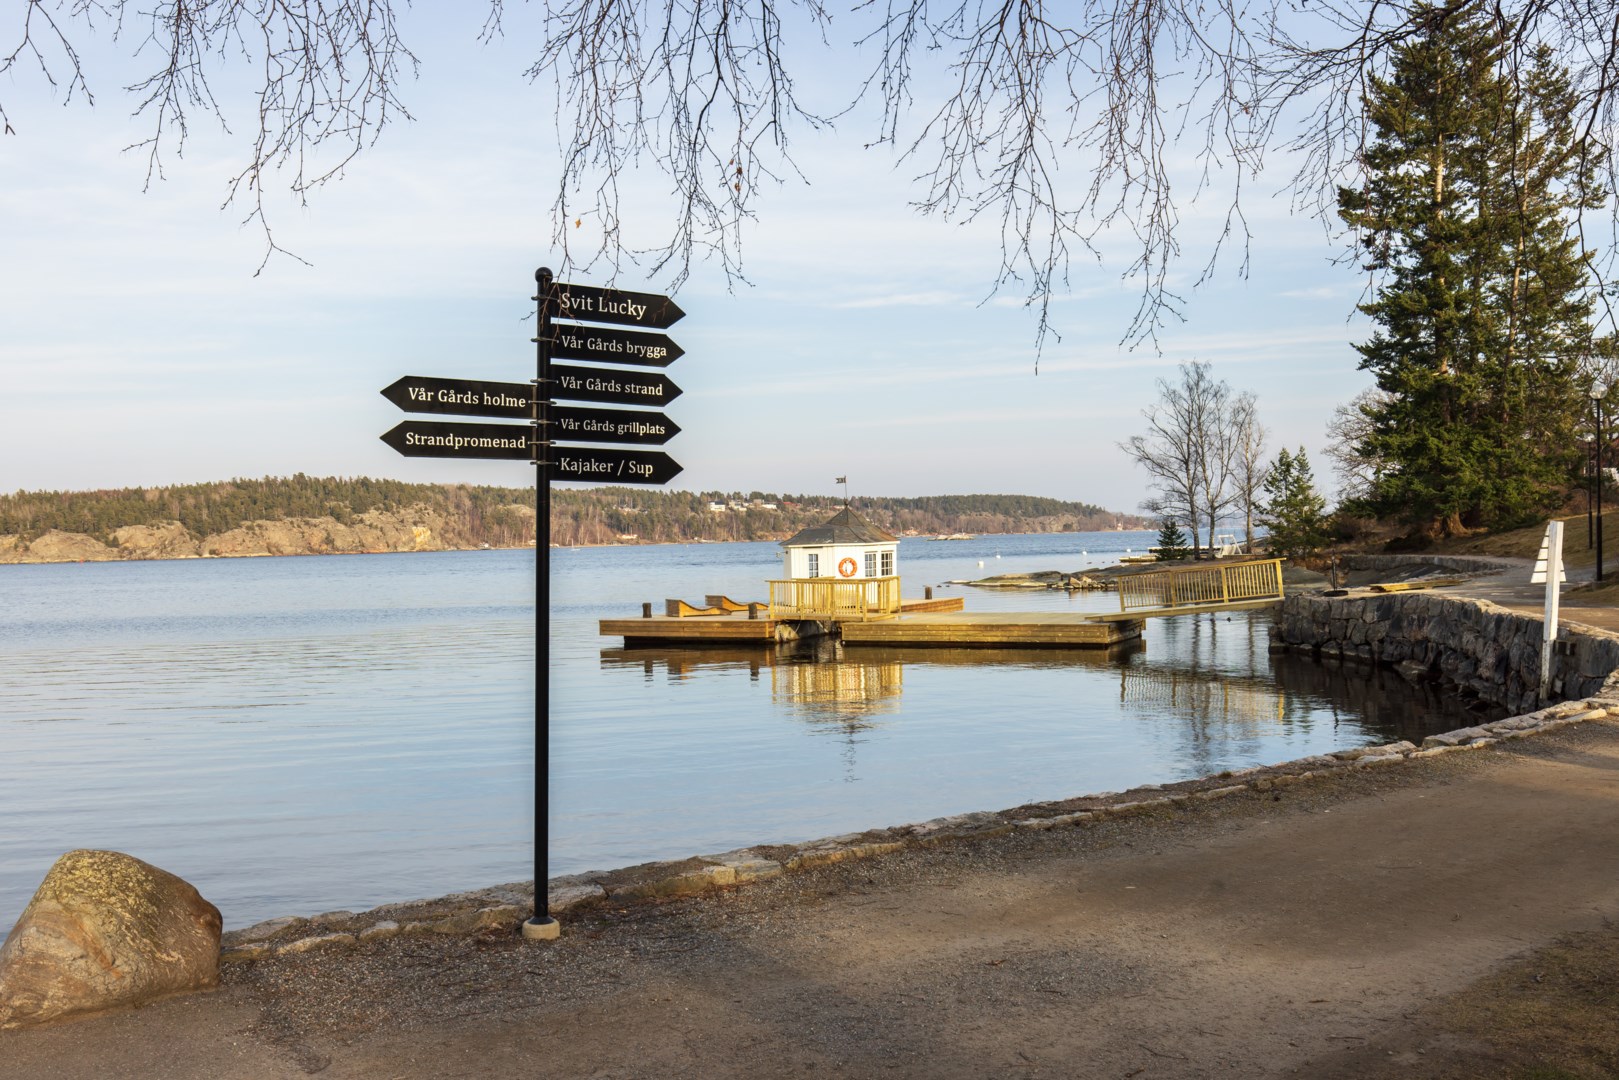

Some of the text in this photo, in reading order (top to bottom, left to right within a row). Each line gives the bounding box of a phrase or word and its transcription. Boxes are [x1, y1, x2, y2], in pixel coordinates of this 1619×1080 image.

[560, 292, 646, 320] Svit Lucky
[561, 335, 667, 359] Vår Gårds brygga
[560, 375, 663, 396] Vår Gårds strand
[408, 386, 526, 407] Vår Gårds holme
[560, 418, 666, 437] Vår Gårds grillplats
[406, 432, 525, 449] Strandpromenad
[561, 458, 653, 477] Kajaker / Sup
